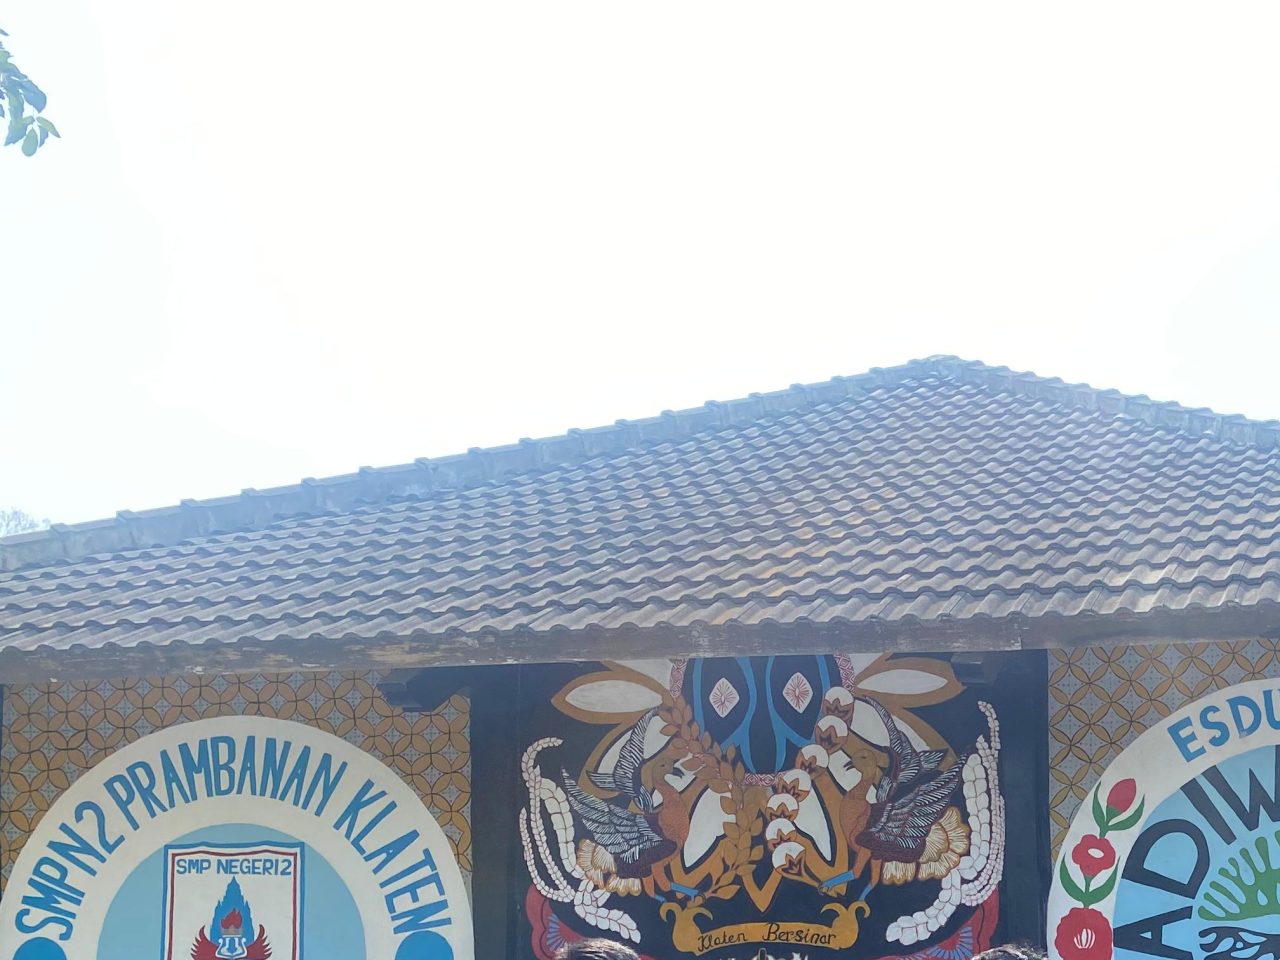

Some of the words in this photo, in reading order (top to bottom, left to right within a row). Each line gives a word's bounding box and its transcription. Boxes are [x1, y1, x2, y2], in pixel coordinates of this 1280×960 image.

[103, 735, 348, 831] PRAMBANAN
[332, 778, 452, 935] KLATEN
[176, 859, 211, 875] SMP
[761, 922, 837, 946] Bersinar
